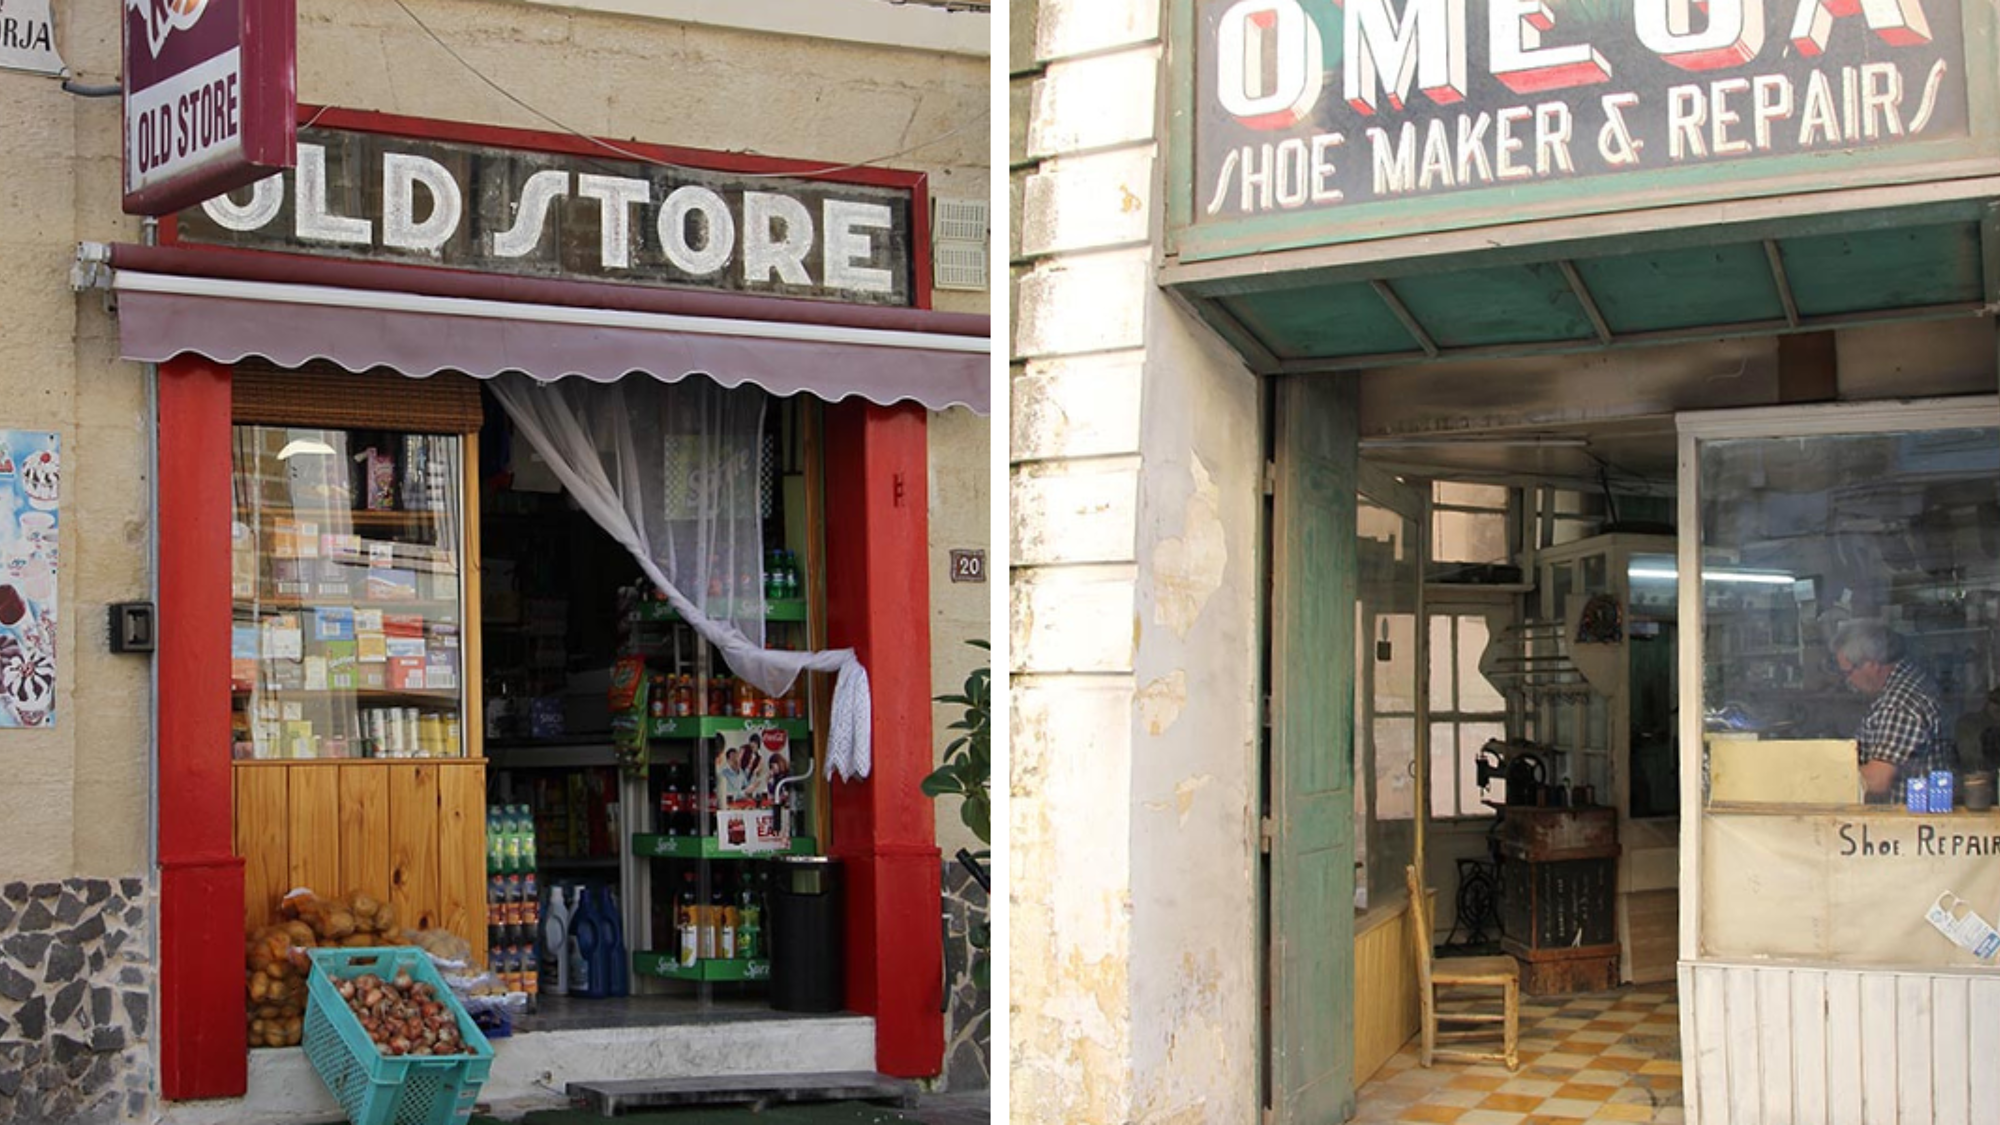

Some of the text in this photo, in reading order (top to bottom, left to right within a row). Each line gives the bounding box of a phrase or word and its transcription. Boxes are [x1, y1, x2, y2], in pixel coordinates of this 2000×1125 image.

[0, 17, 51, 52] RJA
[138, 71, 238, 174] OLD STORE
[1207, 57, 1948, 216] SHOE MAKER & REPAIRS
[493, 169, 893, 293] STORE
[960, 556, 980, 575] 20
